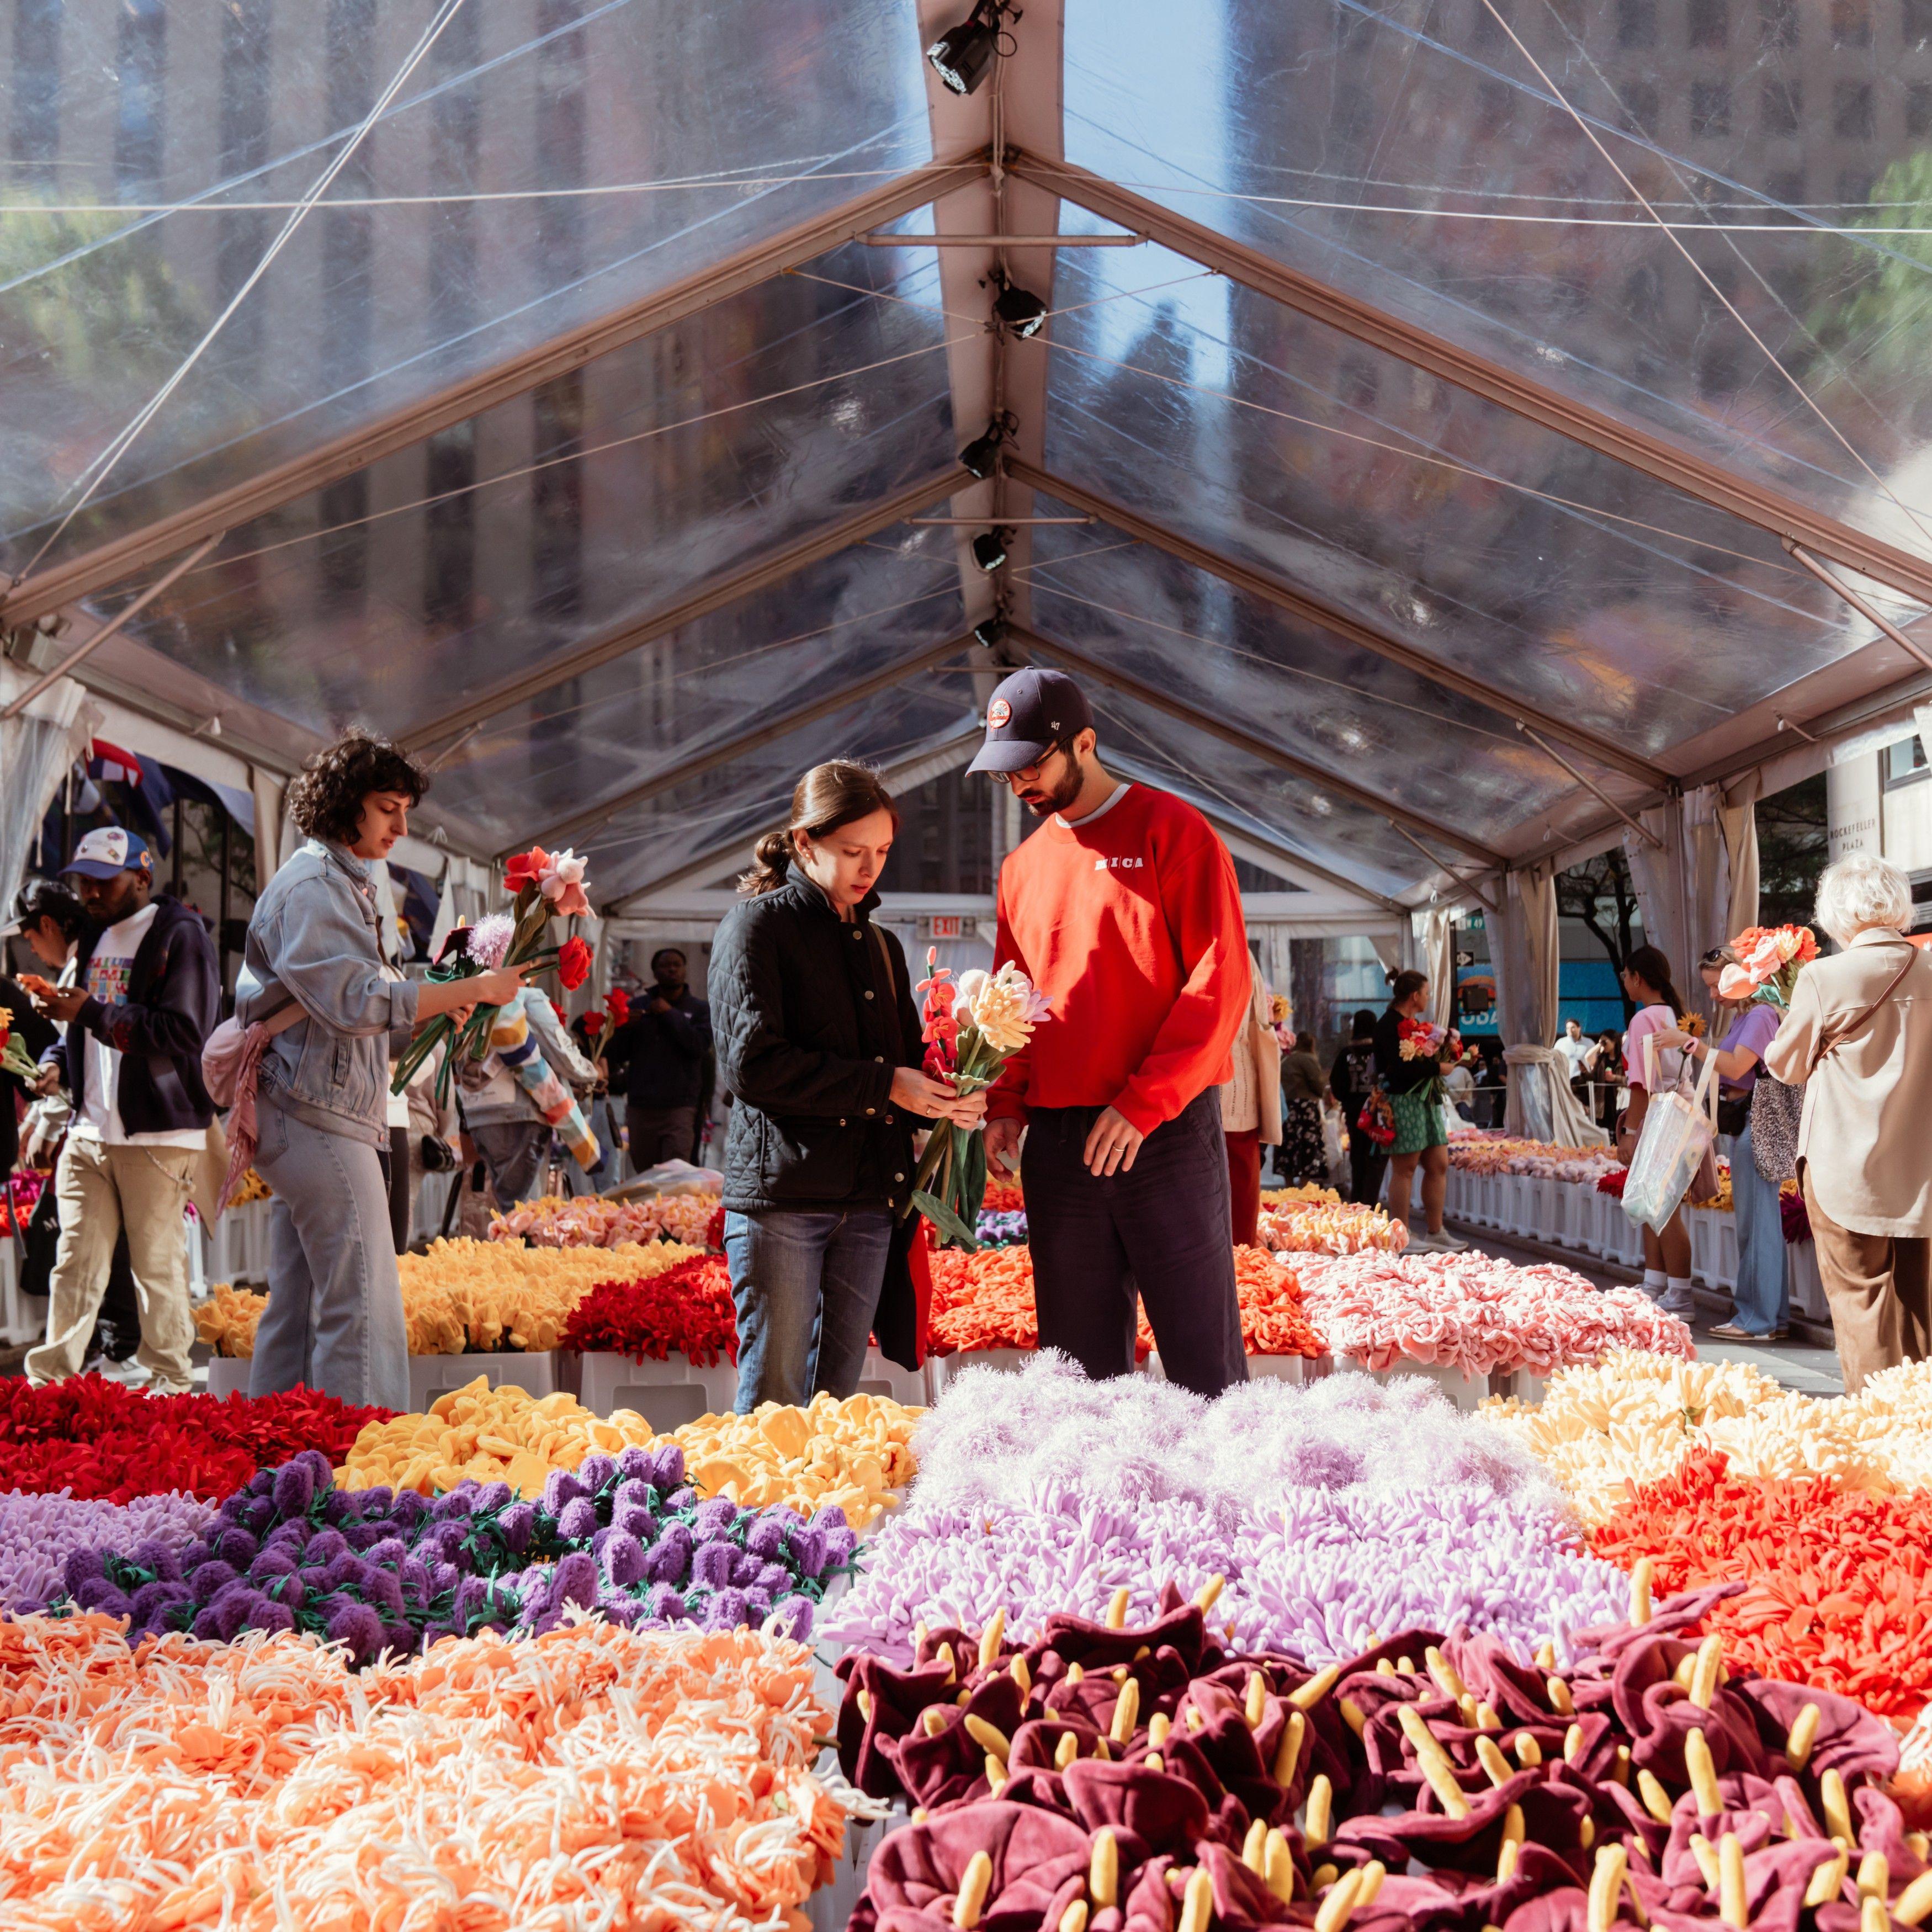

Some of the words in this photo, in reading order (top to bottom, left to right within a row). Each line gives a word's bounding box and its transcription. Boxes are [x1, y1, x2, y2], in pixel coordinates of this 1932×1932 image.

[1830, 818, 1875, 839] ROCKEFELLER
[1843, 839, 1863, 851] PLAZA
[934, 916, 959, 936] EXIT
